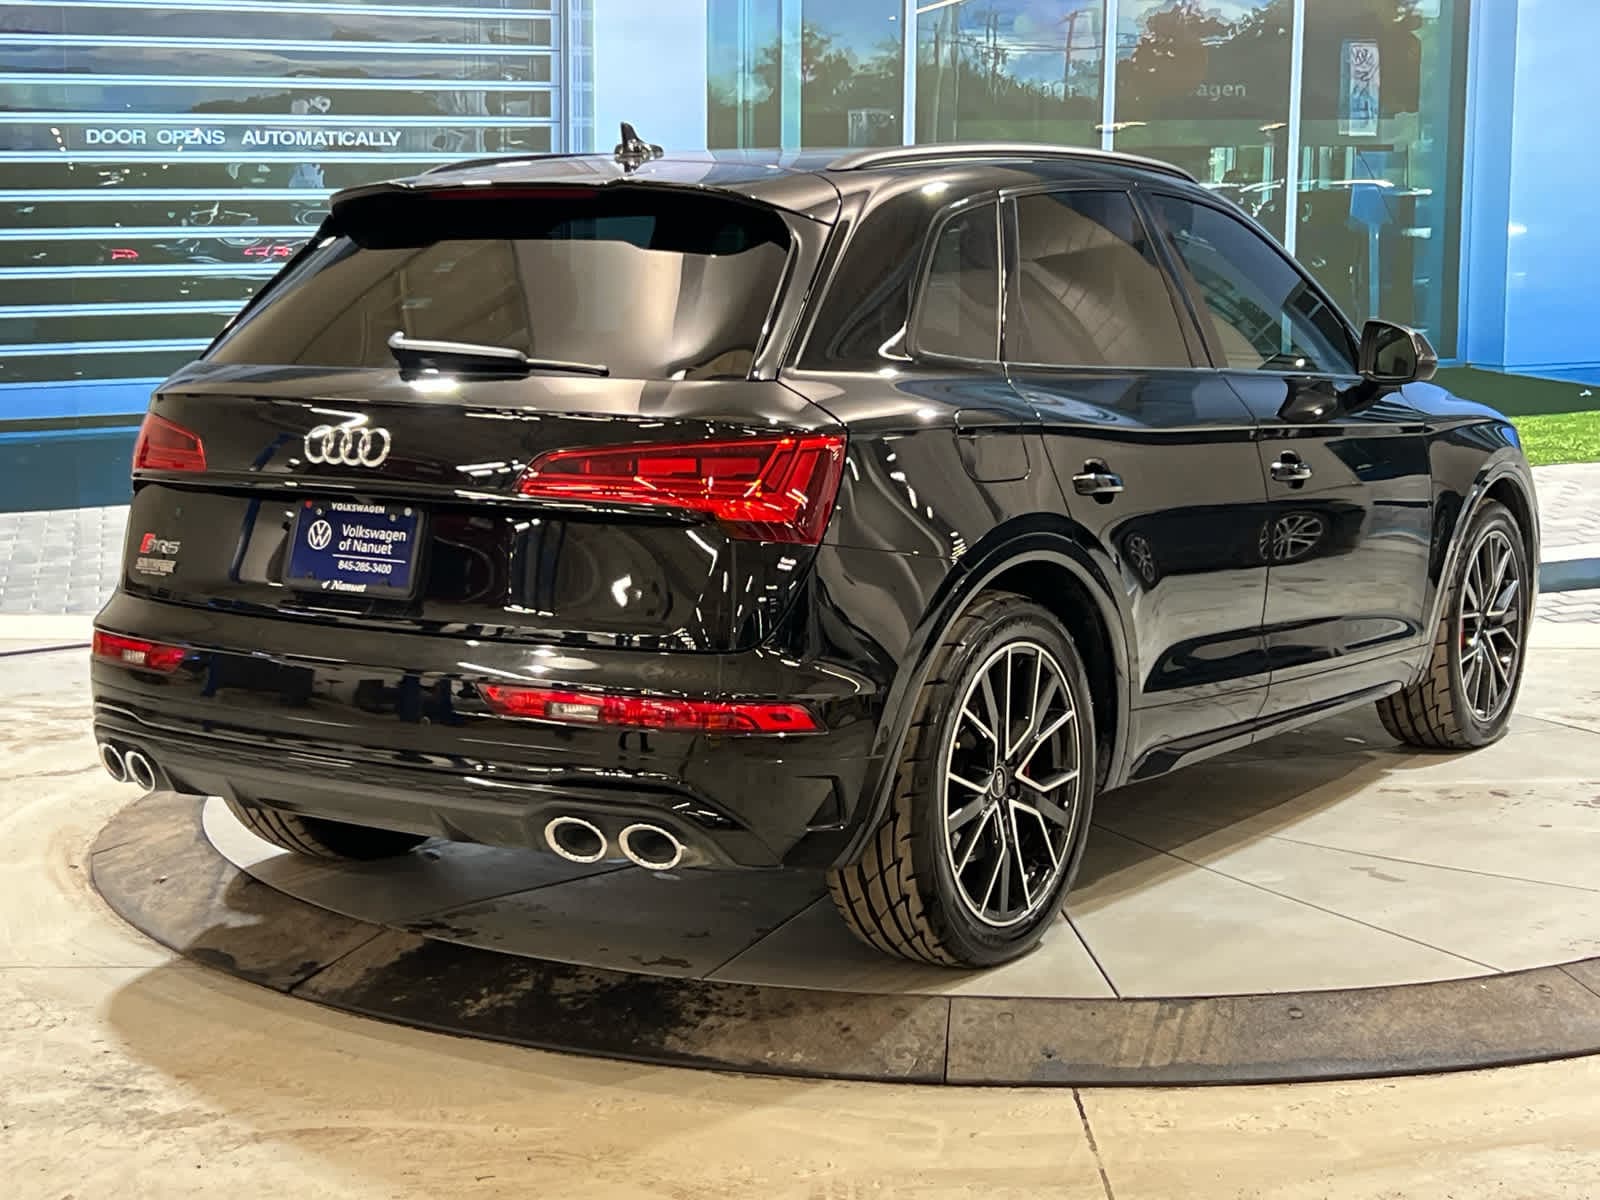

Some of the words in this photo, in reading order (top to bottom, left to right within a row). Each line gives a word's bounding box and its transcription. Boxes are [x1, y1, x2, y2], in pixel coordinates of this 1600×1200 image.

[86, 128, 146, 146] DOOR
[156, 128, 226, 146] OPENS
[241, 129, 402, 147] AUTOMATICALLY
[331, 502, 386, 514] VOLKSWAGEN
[342, 524, 407, 543] Volkswagen
[338, 538, 351, 551] of
[353, 540, 393, 555] Nanuet
